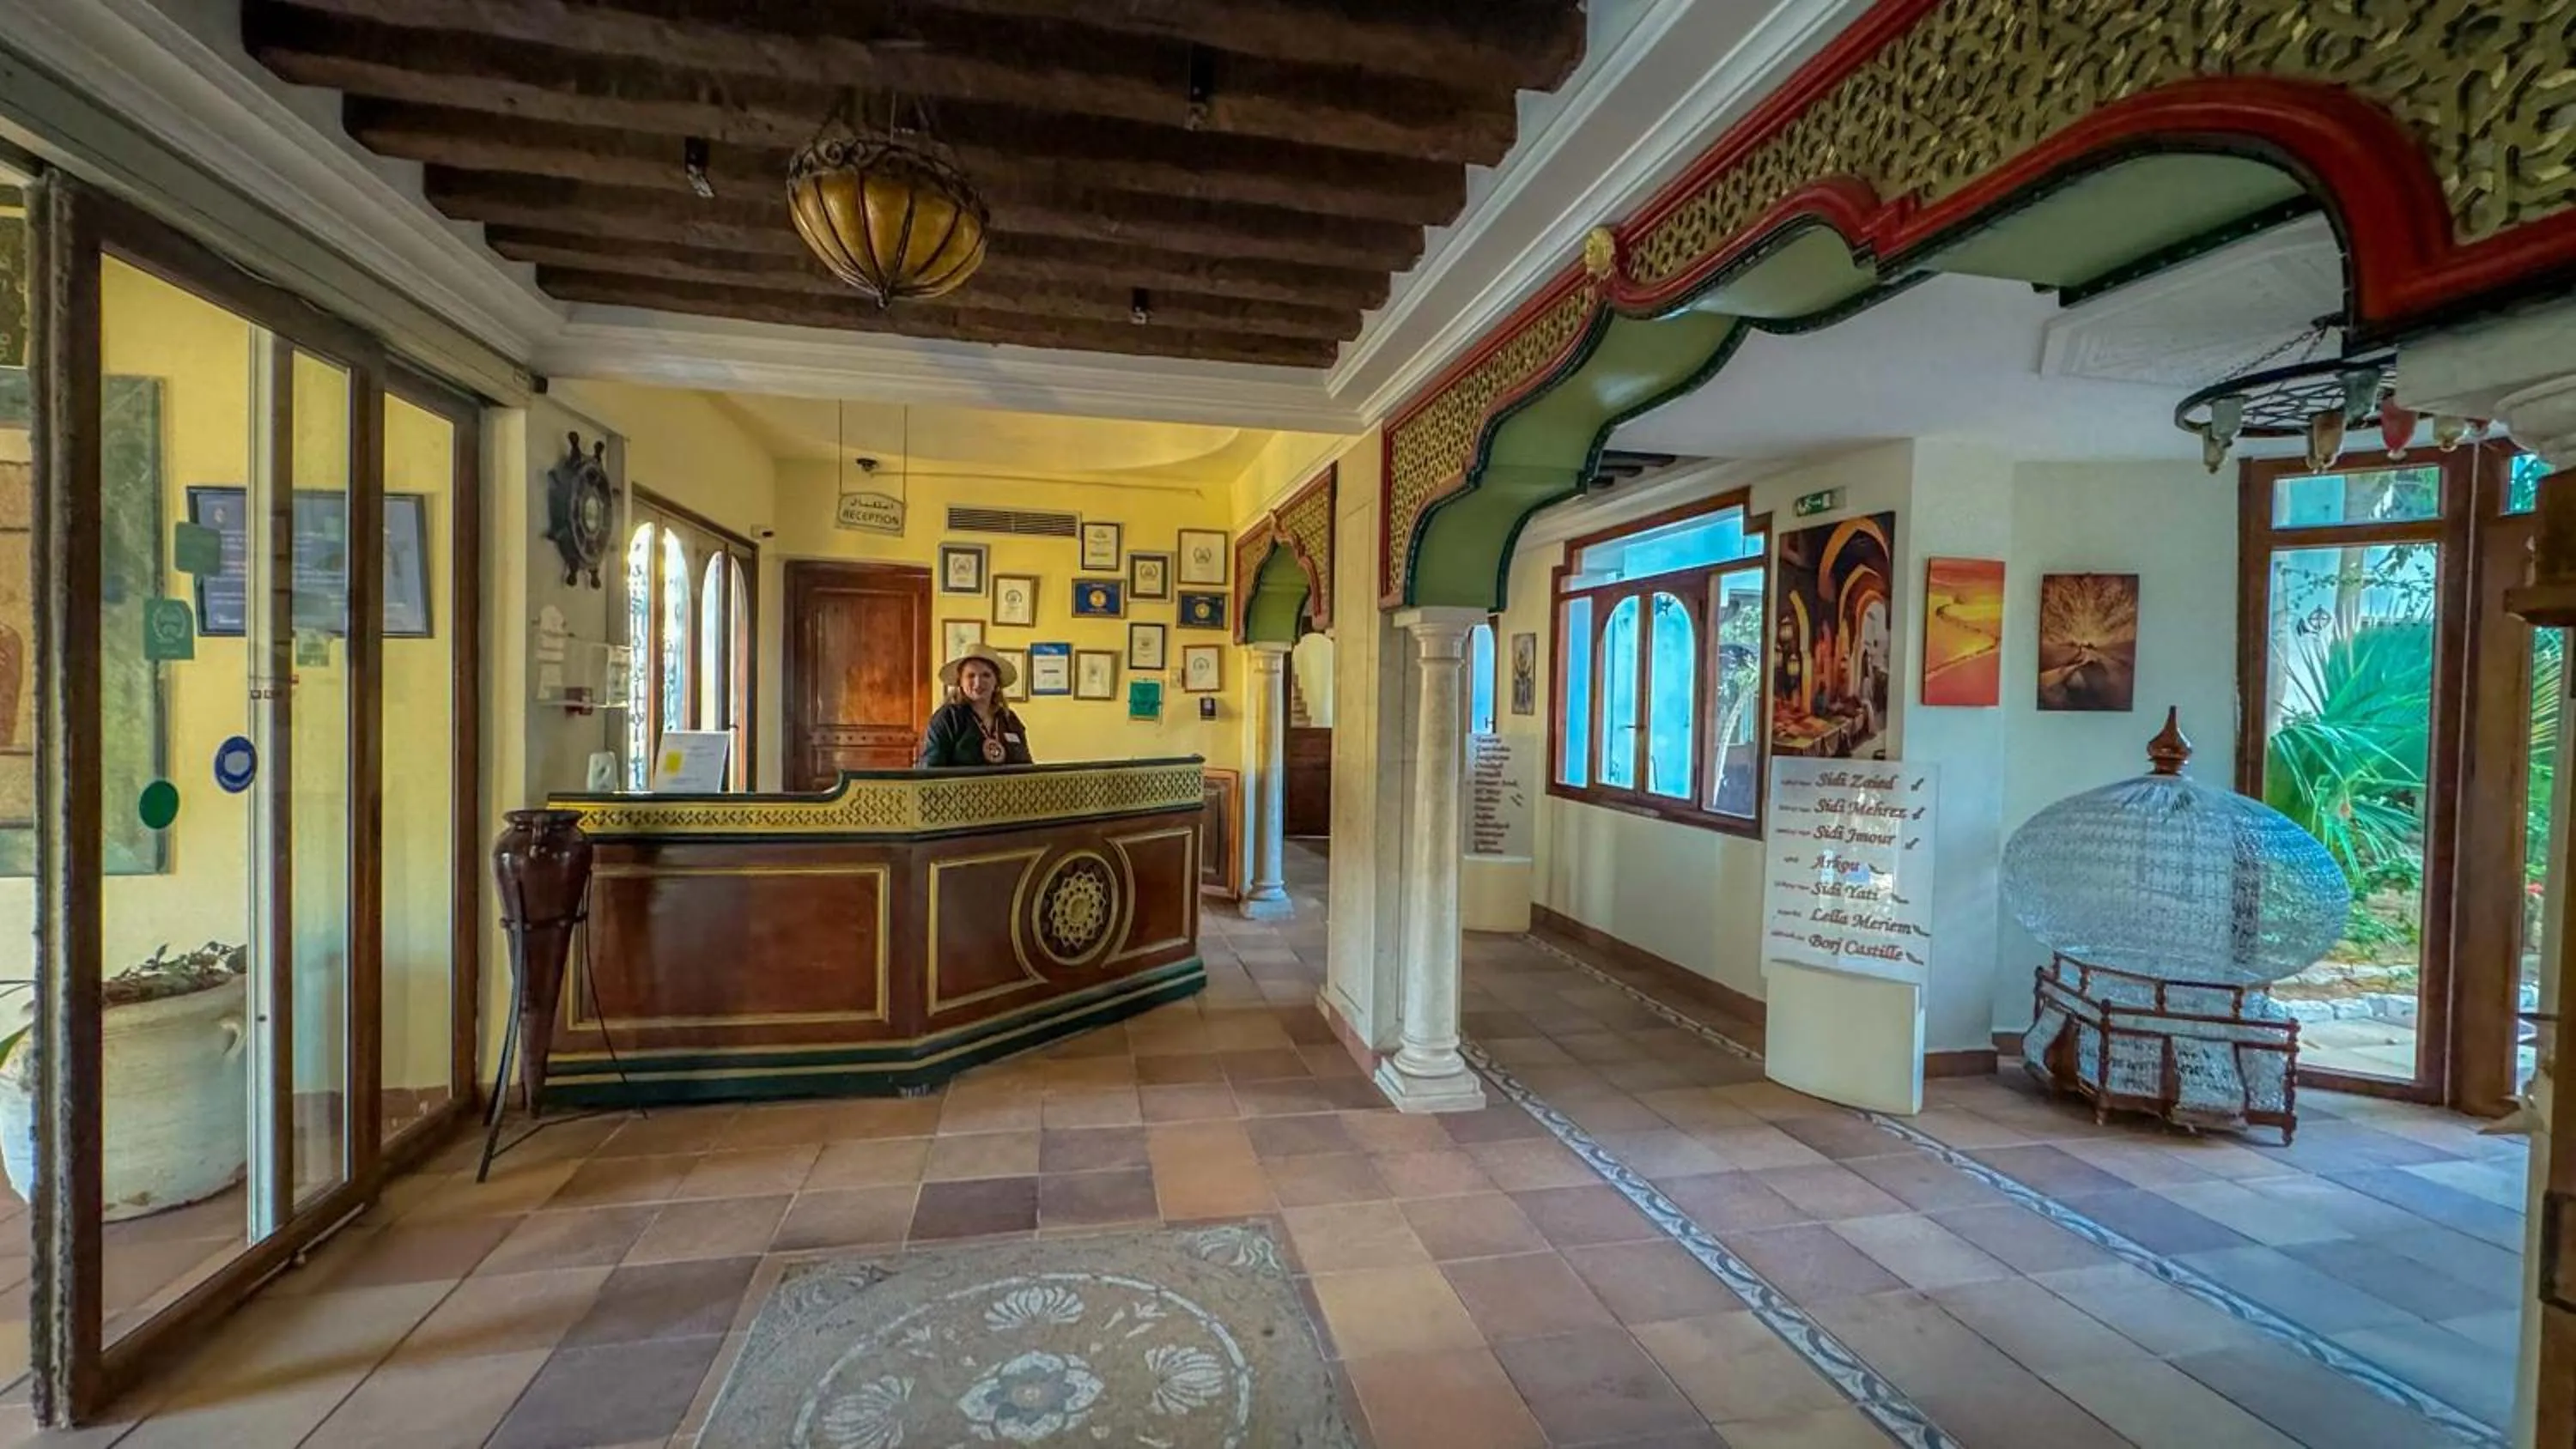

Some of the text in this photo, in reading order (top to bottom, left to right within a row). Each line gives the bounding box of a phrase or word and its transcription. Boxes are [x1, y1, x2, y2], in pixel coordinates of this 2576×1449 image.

[842, 509, 900, 524] RECEPTION
[1814, 771, 1847, 787] Sidi
[1814, 797, 1845, 813] Sidi
[1813, 824, 1844, 840] Sidi
[1845, 828, 1896, 845] Jmour
[1811, 881, 1842, 896] Sidi
[1809, 907, 1912, 935] Lella Meriem
[1808, 933, 1843, 955] Borj
[1845, 940, 1905, 961] Castille
